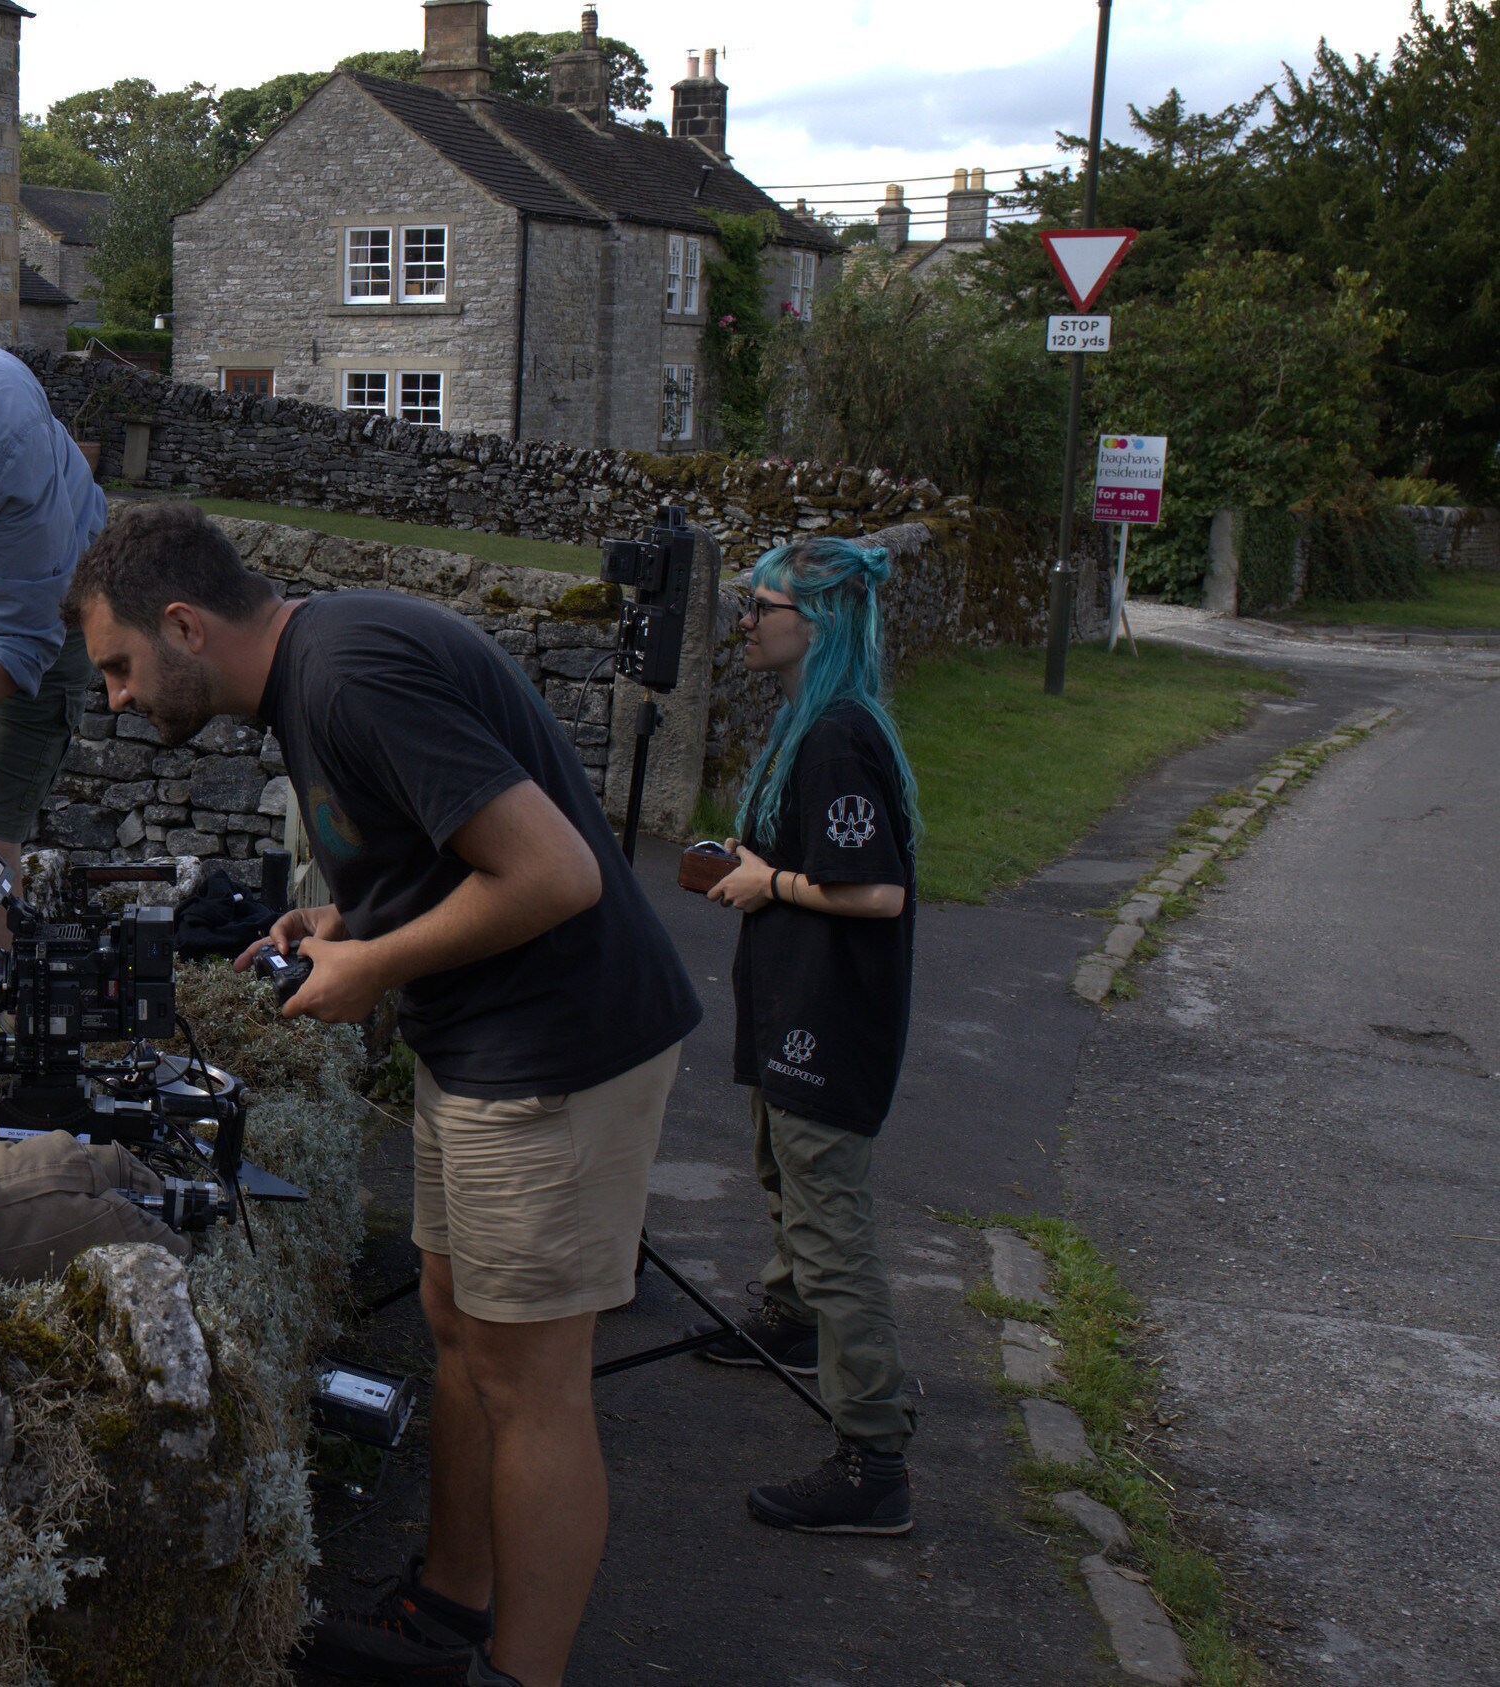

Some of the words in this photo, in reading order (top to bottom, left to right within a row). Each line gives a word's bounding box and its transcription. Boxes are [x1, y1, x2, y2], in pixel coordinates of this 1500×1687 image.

[1060, 320, 1100, 332] STOP
[1052, 335, 1077, 346] 120
[1080, 335, 1105, 348] yds
[1100, 451, 1160, 466] bagshaws
[1099, 466, 1162, 479] residential
[1098, 488, 1117, 500] for
[1119, 490, 1146, 501] sale
